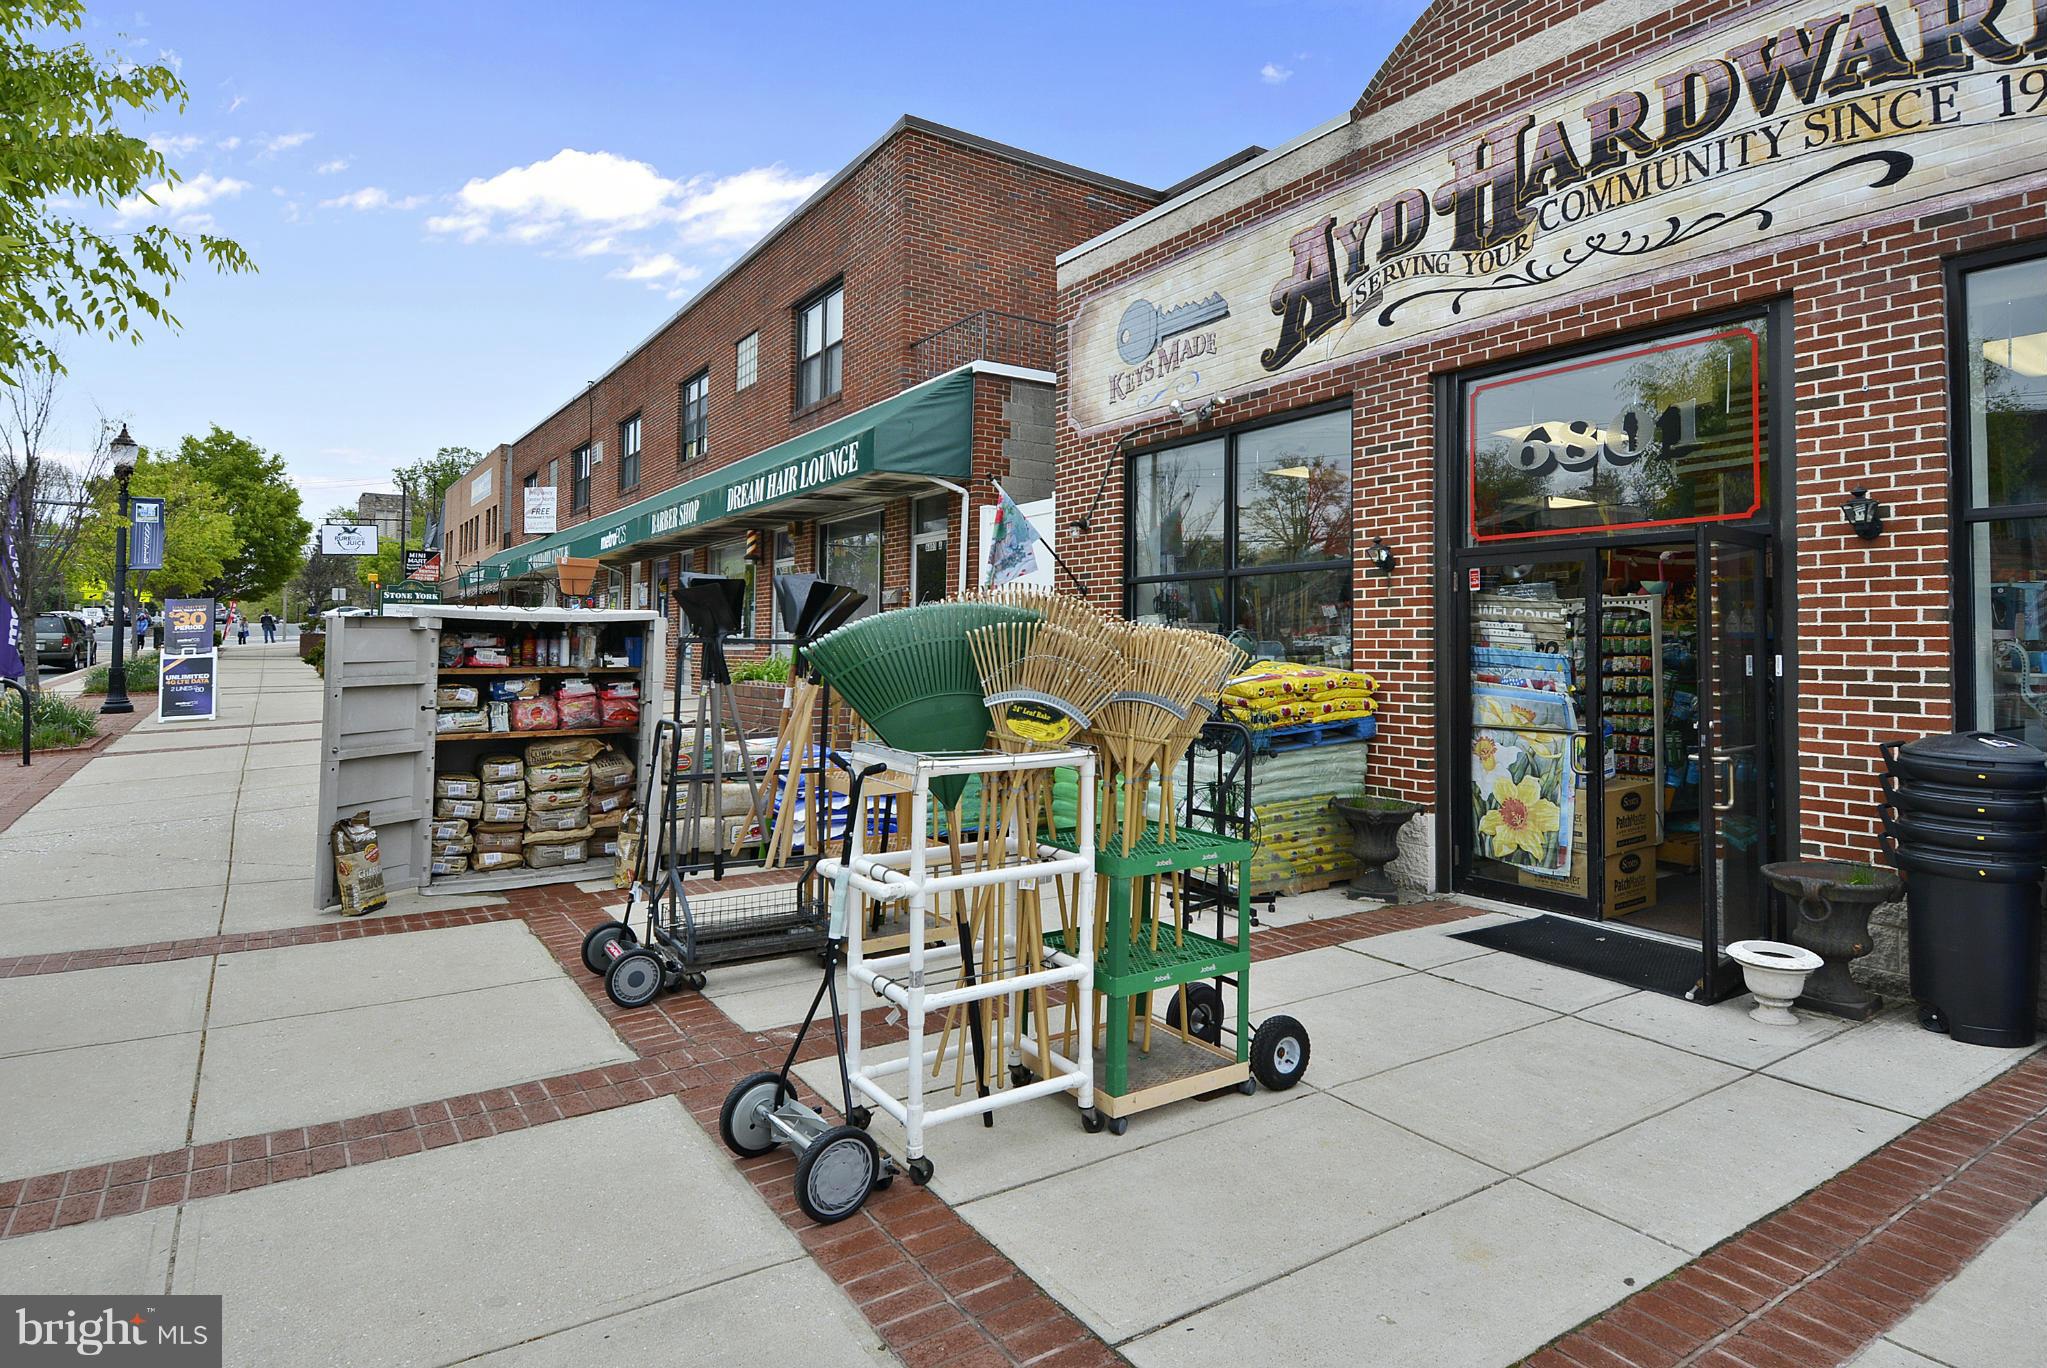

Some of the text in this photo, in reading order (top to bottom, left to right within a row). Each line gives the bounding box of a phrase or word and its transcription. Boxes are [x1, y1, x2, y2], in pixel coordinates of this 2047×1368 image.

[1261, 0, 2047, 372] AYD HARDWAR
[1355, 253, 1450, 305] SERVING
[1464, 233, 1532, 275] YOUR
[1539, 120, 1791, 231] COMMUNITY
[1804, 81, 1962, 150] SINCE
[1108, 333, 1217, 404] KEYS MADE
[1507, 398, 1704, 473] 6801
[726, 441, 858, 512] DREAM HAIR LOUNGE
[600, 525, 627, 550] metroPCS
[651, 499, 700, 534] BARBER SHOP
[168, 611, 207, 626] $30
[383, 591, 439, 600] STONE YORK
[1023, 707, 1037, 716] Leaf
[1036, 711, 1051, 721] Rake
